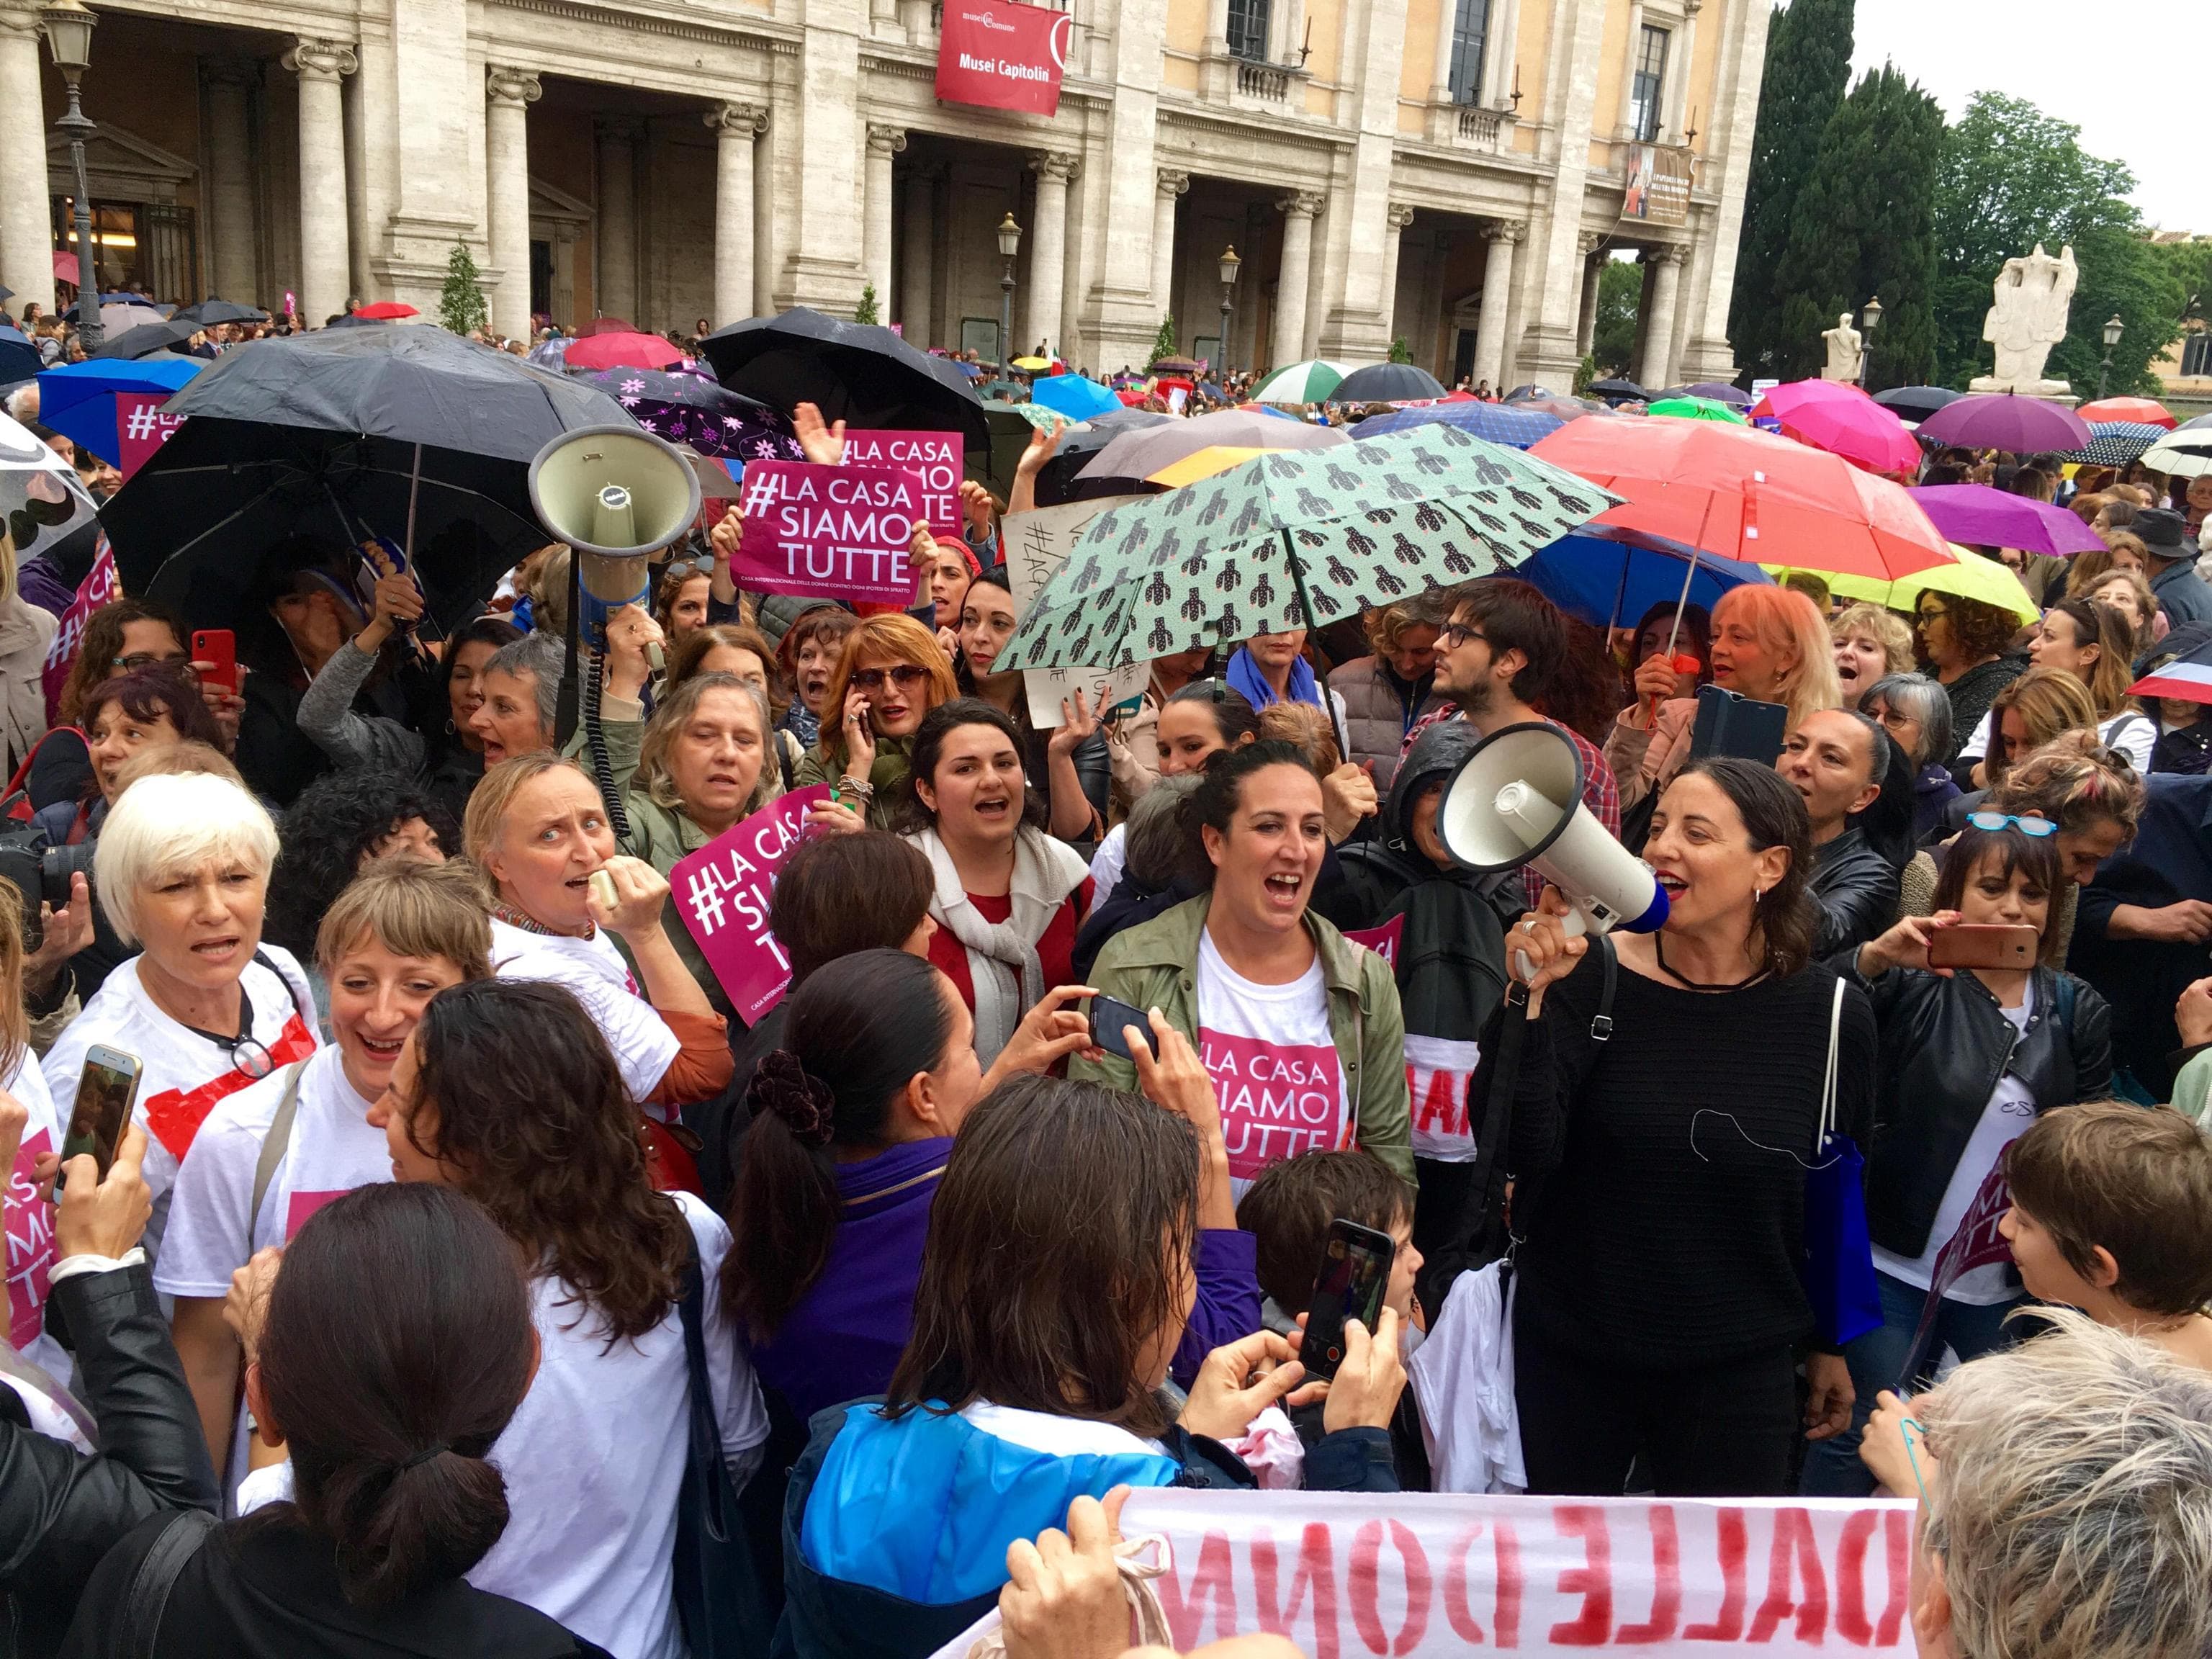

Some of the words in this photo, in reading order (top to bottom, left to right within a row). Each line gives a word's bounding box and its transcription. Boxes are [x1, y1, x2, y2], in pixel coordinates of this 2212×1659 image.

[959, 53, 995, 73] Musei
[889, 441, 955, 462] CASA
[744, 472, 819, 518] #LA
[828, 479, 912, 509] CASA
[779, 506, 912, 545] SIAMO
[778, 542, 911, 584] TUTTE
[688, 848, 758, 936] #LA
[755, 804, 819, 860] CASA
[750, 999, 765, 1011] CASA
[1199, 1041, 1238, 1076] LA
[1249, 1055, 1328, 1085] CASA
[1210, 1076, 1330, 1124] IAMO
[1222, 1118, 1328, 1160] UTTE
